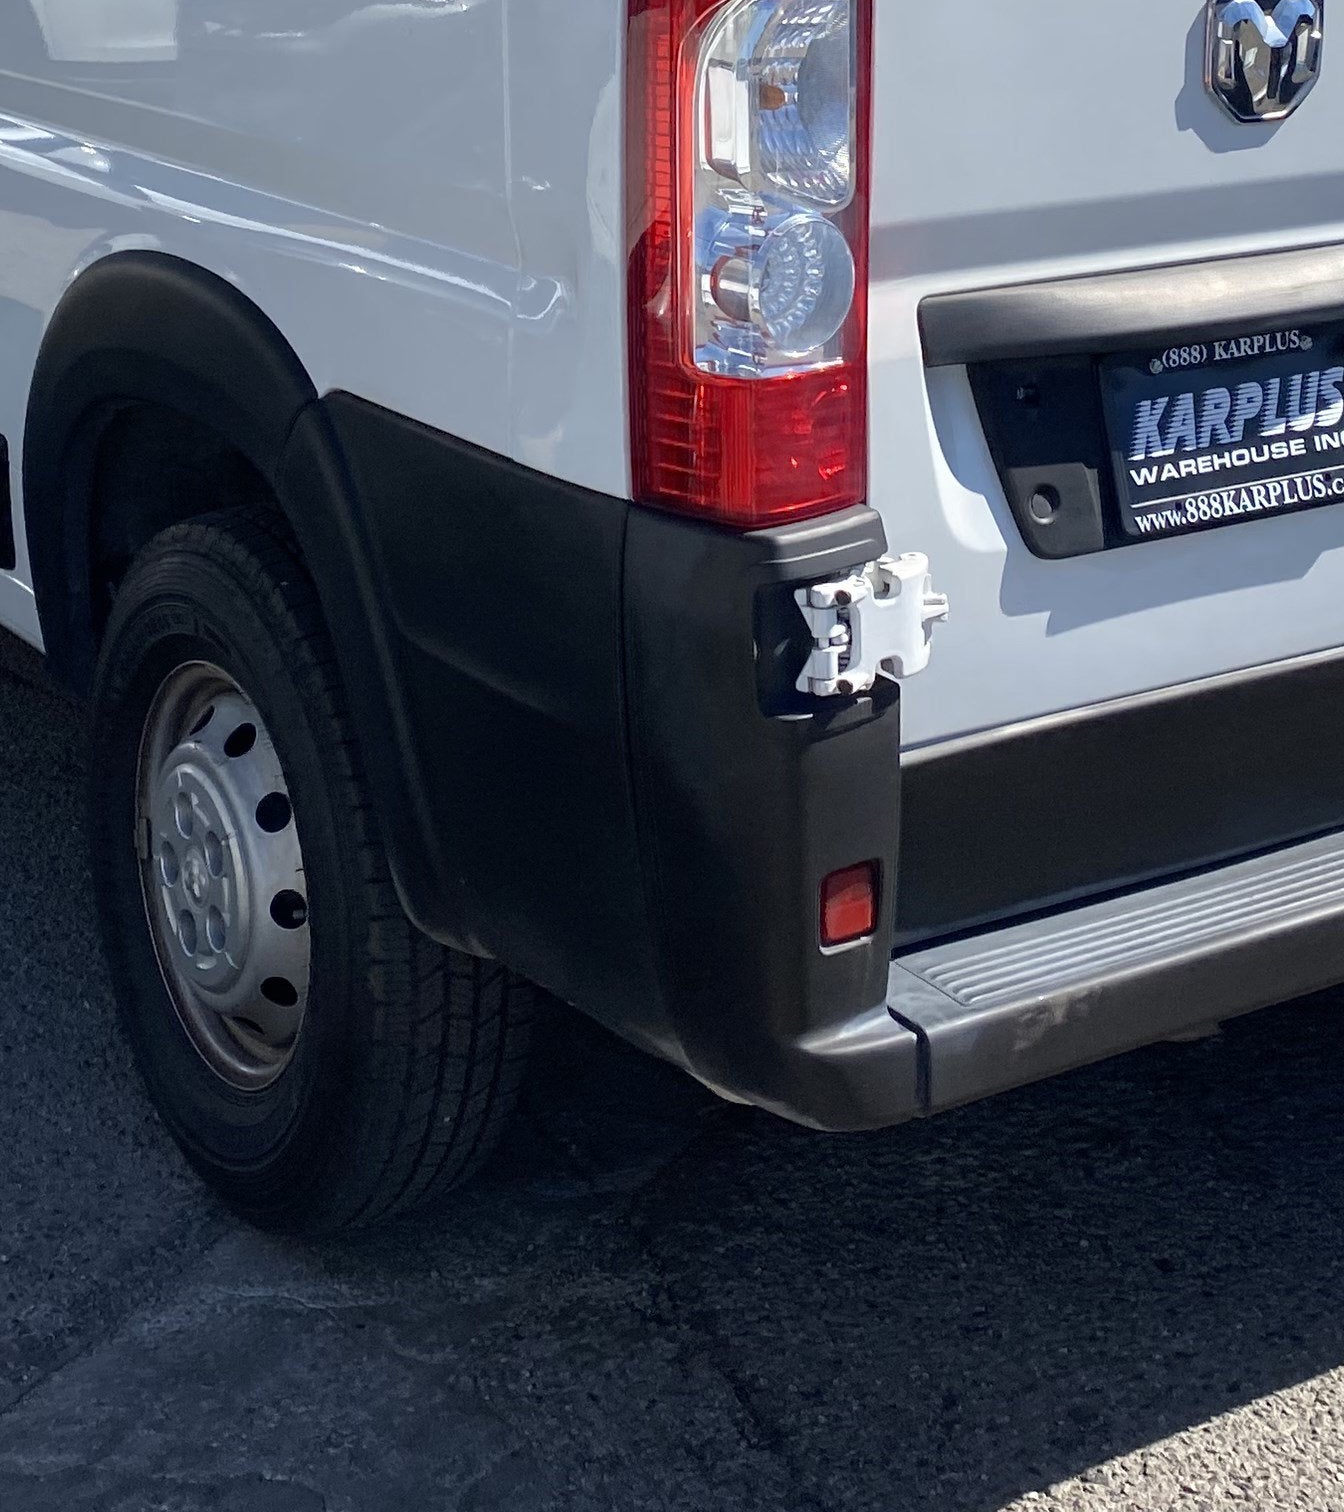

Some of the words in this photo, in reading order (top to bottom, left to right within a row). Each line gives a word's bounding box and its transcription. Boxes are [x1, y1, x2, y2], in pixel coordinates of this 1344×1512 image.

[1161, 346, 1208, 369] (888)
[1213, 330, 1300, 361] KARPLUS
[1128, 366, 1344, 461] KARPLUS
[1129, 438, 1307, 487] WAREHOUSE
